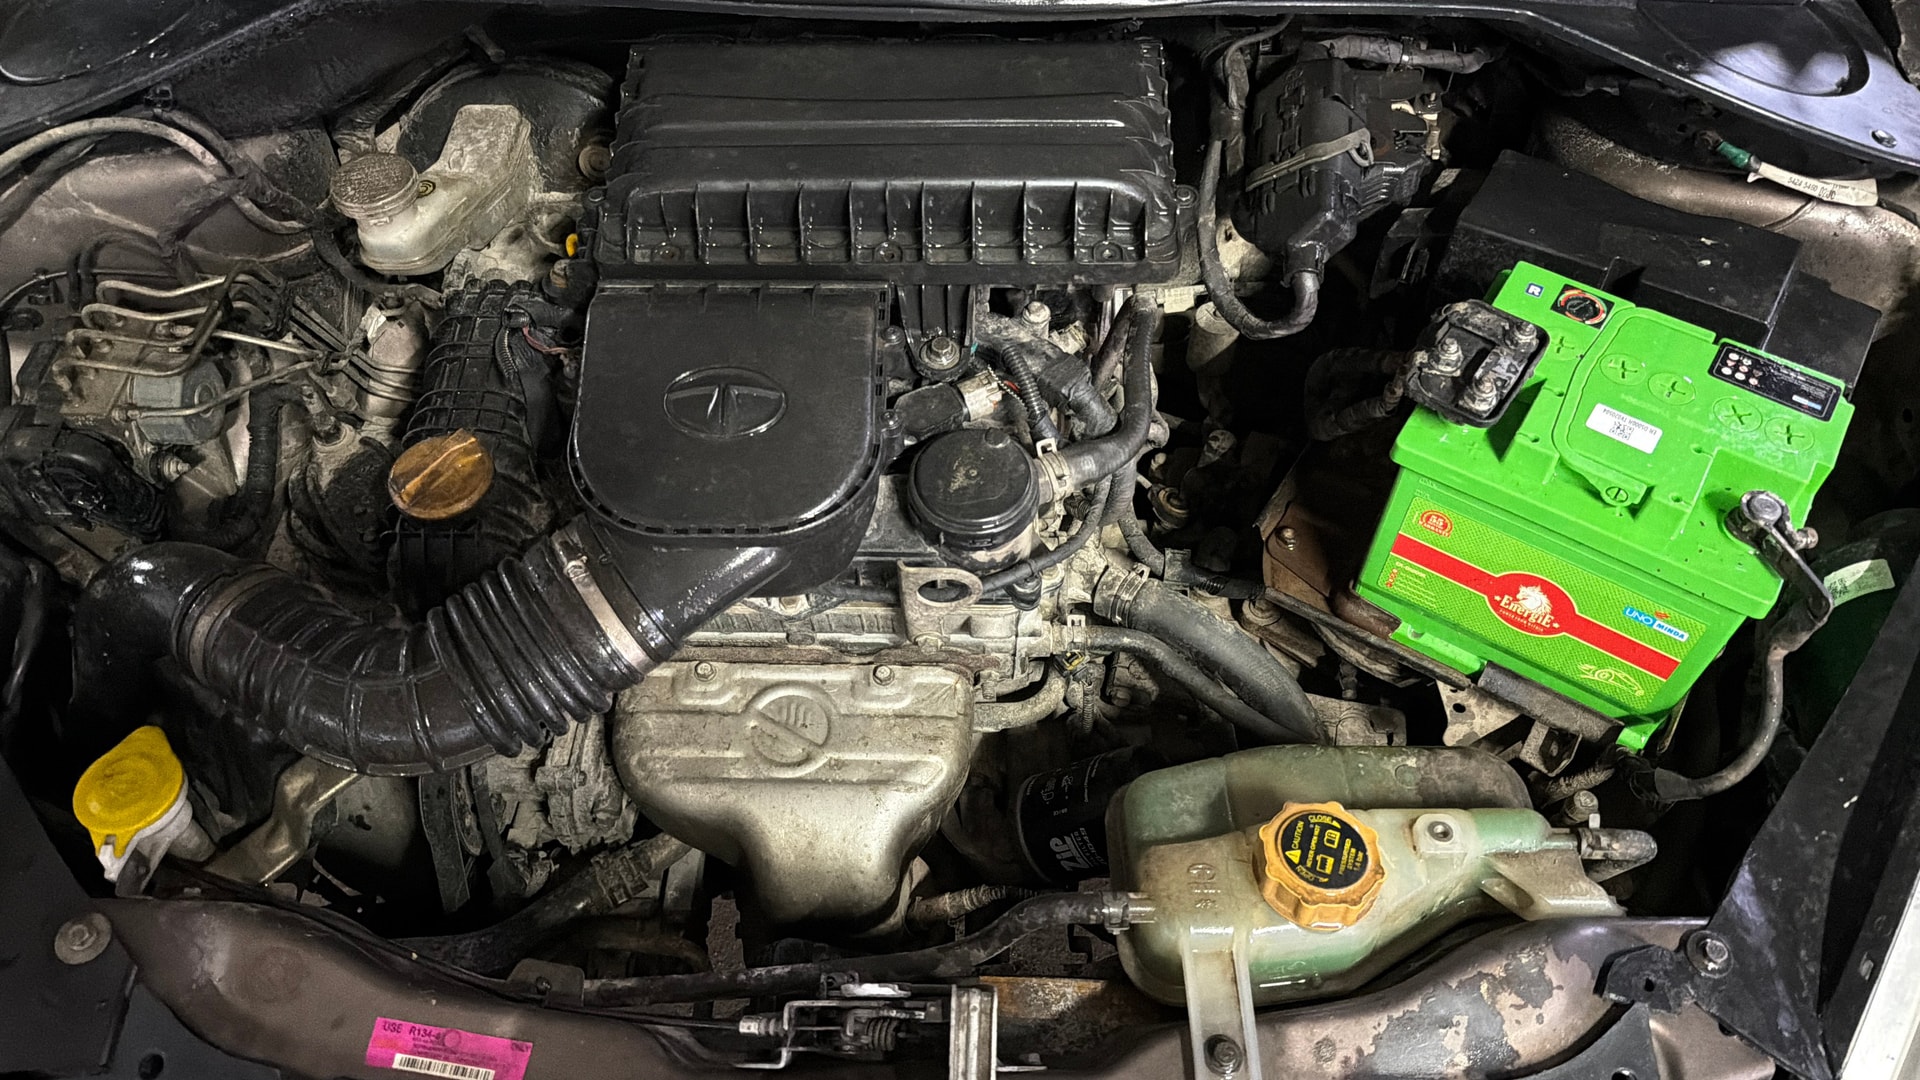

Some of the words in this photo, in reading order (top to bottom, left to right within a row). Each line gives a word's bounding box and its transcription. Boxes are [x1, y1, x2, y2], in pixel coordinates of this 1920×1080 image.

[1528, 284, 1541, 296] R
[1625, 607, 1654, 625] UNO
[1655, 622, 1686, 640] MINDA
[1292, 821, 1304, 849] CAUTION
[383, 1021, 402, 1034] USE
